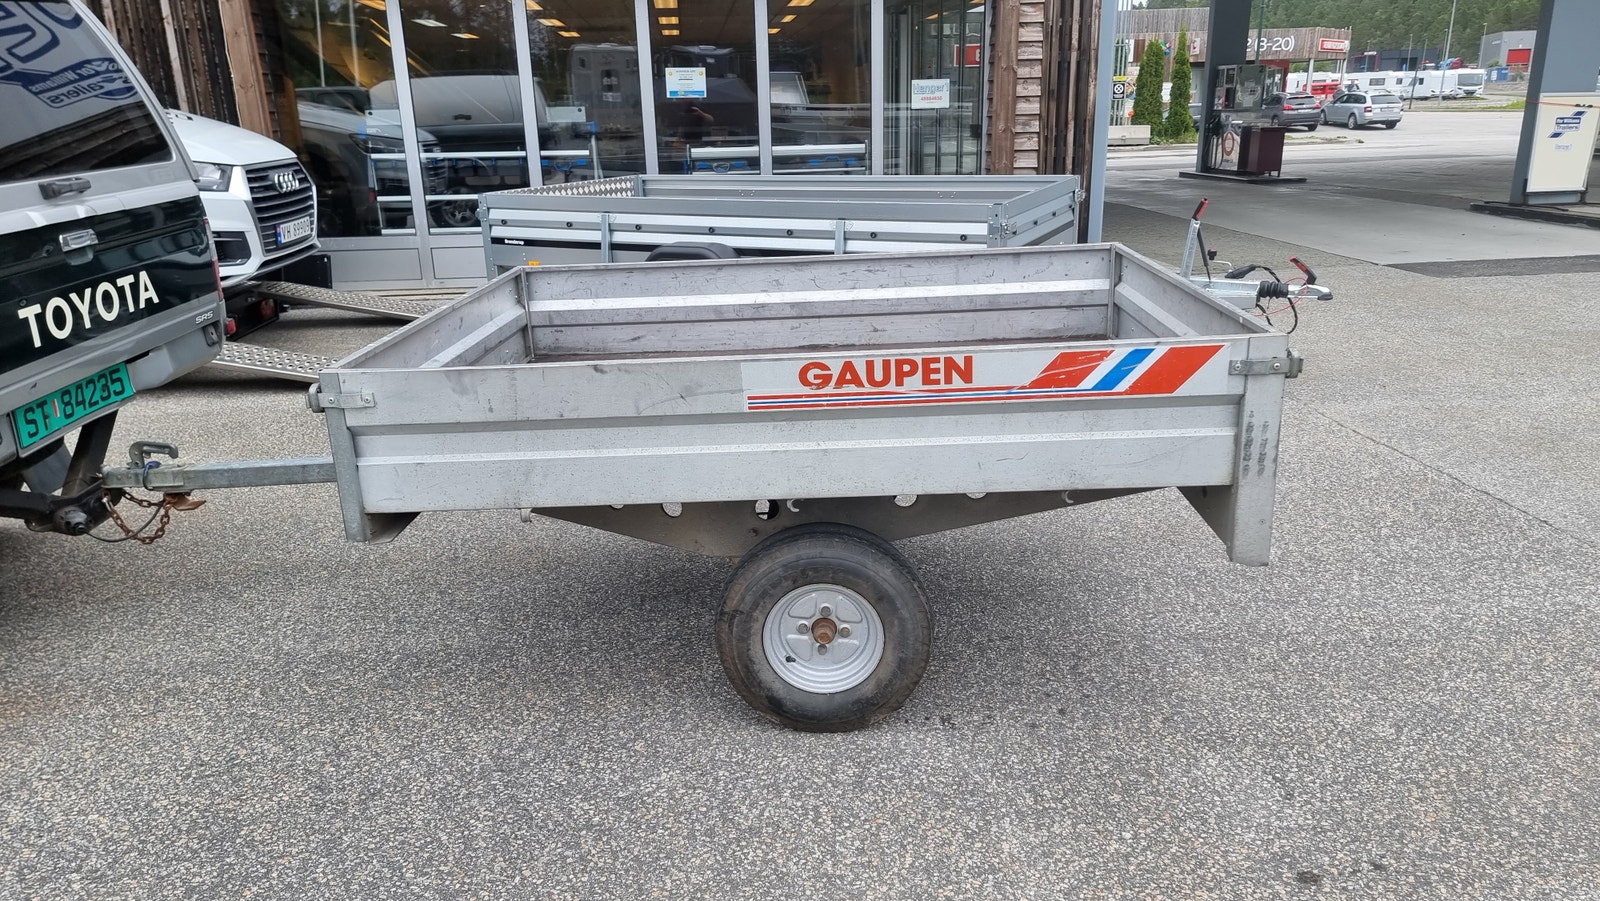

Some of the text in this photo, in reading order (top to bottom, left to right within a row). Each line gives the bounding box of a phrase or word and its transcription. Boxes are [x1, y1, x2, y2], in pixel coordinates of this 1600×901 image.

[18, 270, 159, 348] TOYOTA
[23, 367, 125, 439] ST 84235
[798, 355, 973, 390] GAUPEN
